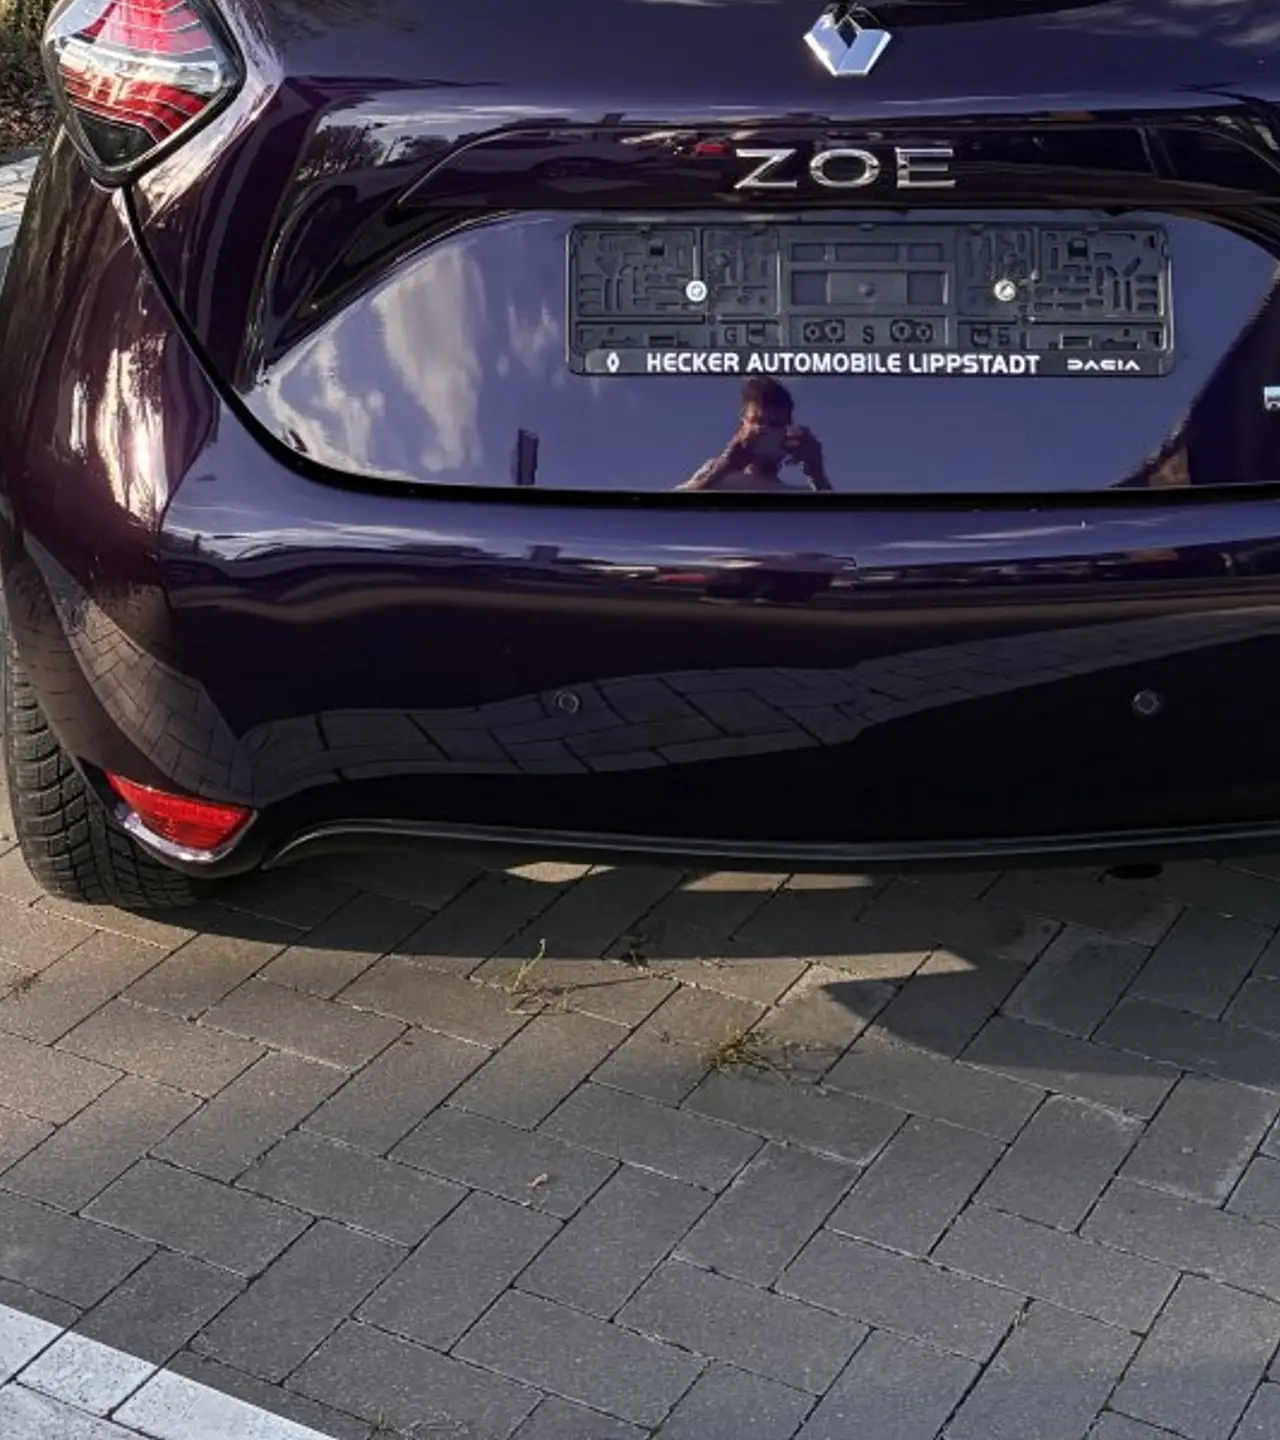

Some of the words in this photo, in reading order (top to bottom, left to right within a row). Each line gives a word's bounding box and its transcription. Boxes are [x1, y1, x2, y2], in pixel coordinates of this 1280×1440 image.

[734, 146, 956, 189] ZOE
[646, 353, 740, 373] HECKER
[746, 352, 902, 373] AUTOMOBILE
[908, 354, 1040, 374] LIPPSTADT
[1066, 360, 1141, 372] DACIA
